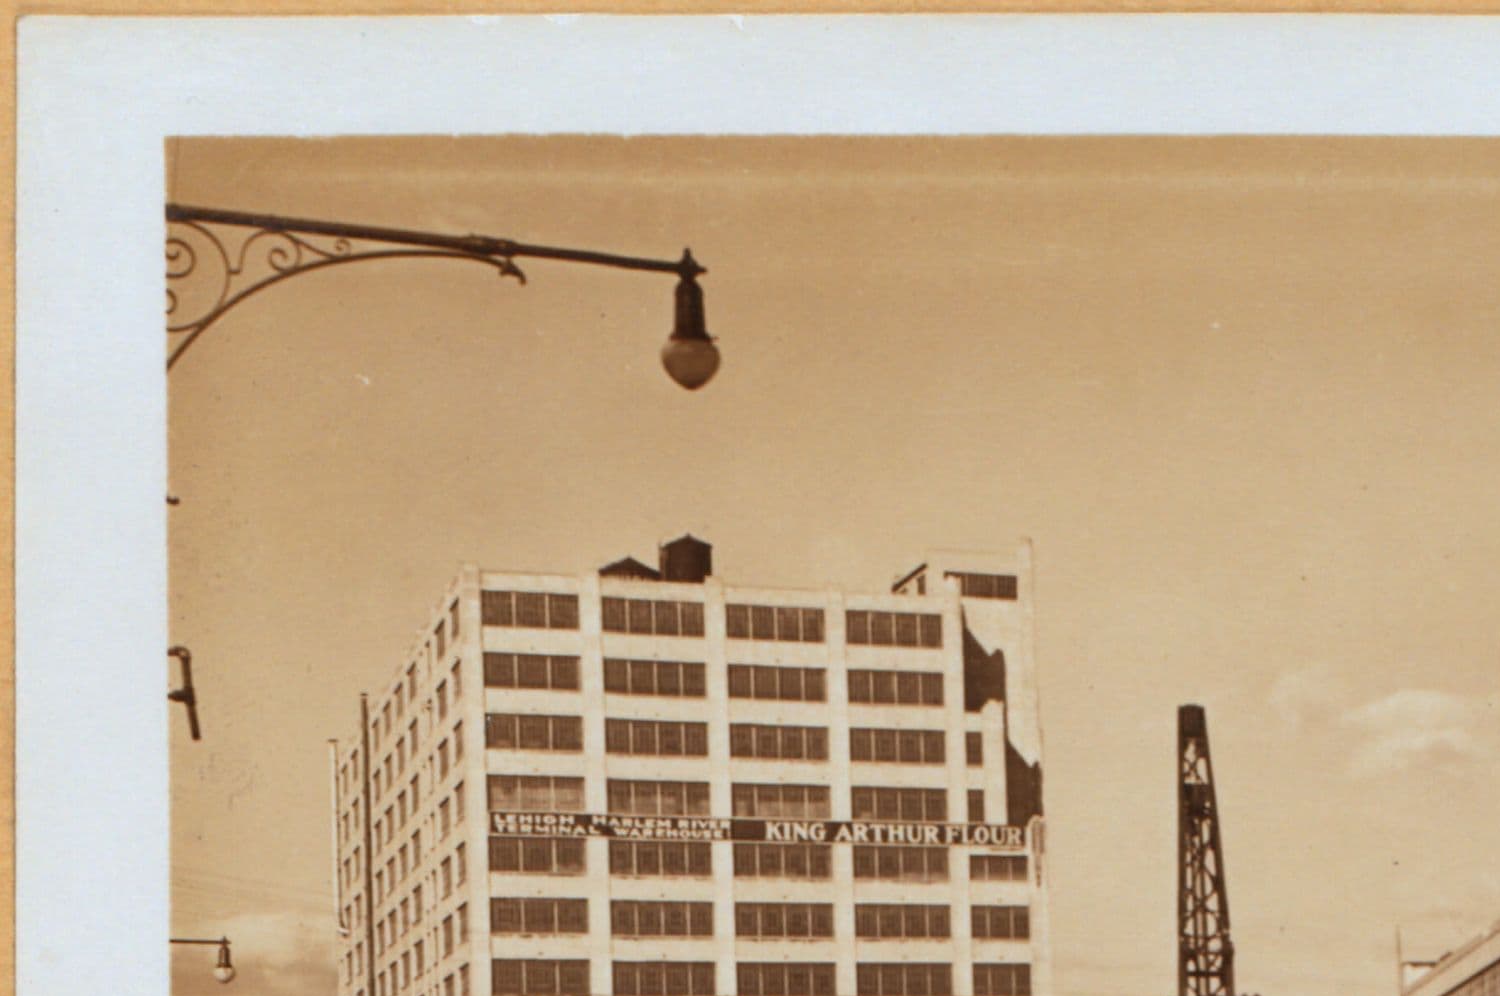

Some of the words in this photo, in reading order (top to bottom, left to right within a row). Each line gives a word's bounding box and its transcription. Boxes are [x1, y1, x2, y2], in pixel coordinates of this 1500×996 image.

[494, 813, 575, 827] LEHIGH
[592, 815, 675, 831] HARLEM
[678, 819, 731, 831] RIVER
[495, 824, 601, 837] TERMINAL
[613, 826, 724, 840] WAREHOUSE
[765, 821, 826, 843] KING
[834, 821, 939, 845] ARTHUR
[945, 823, 1023, 846] FLOUR
